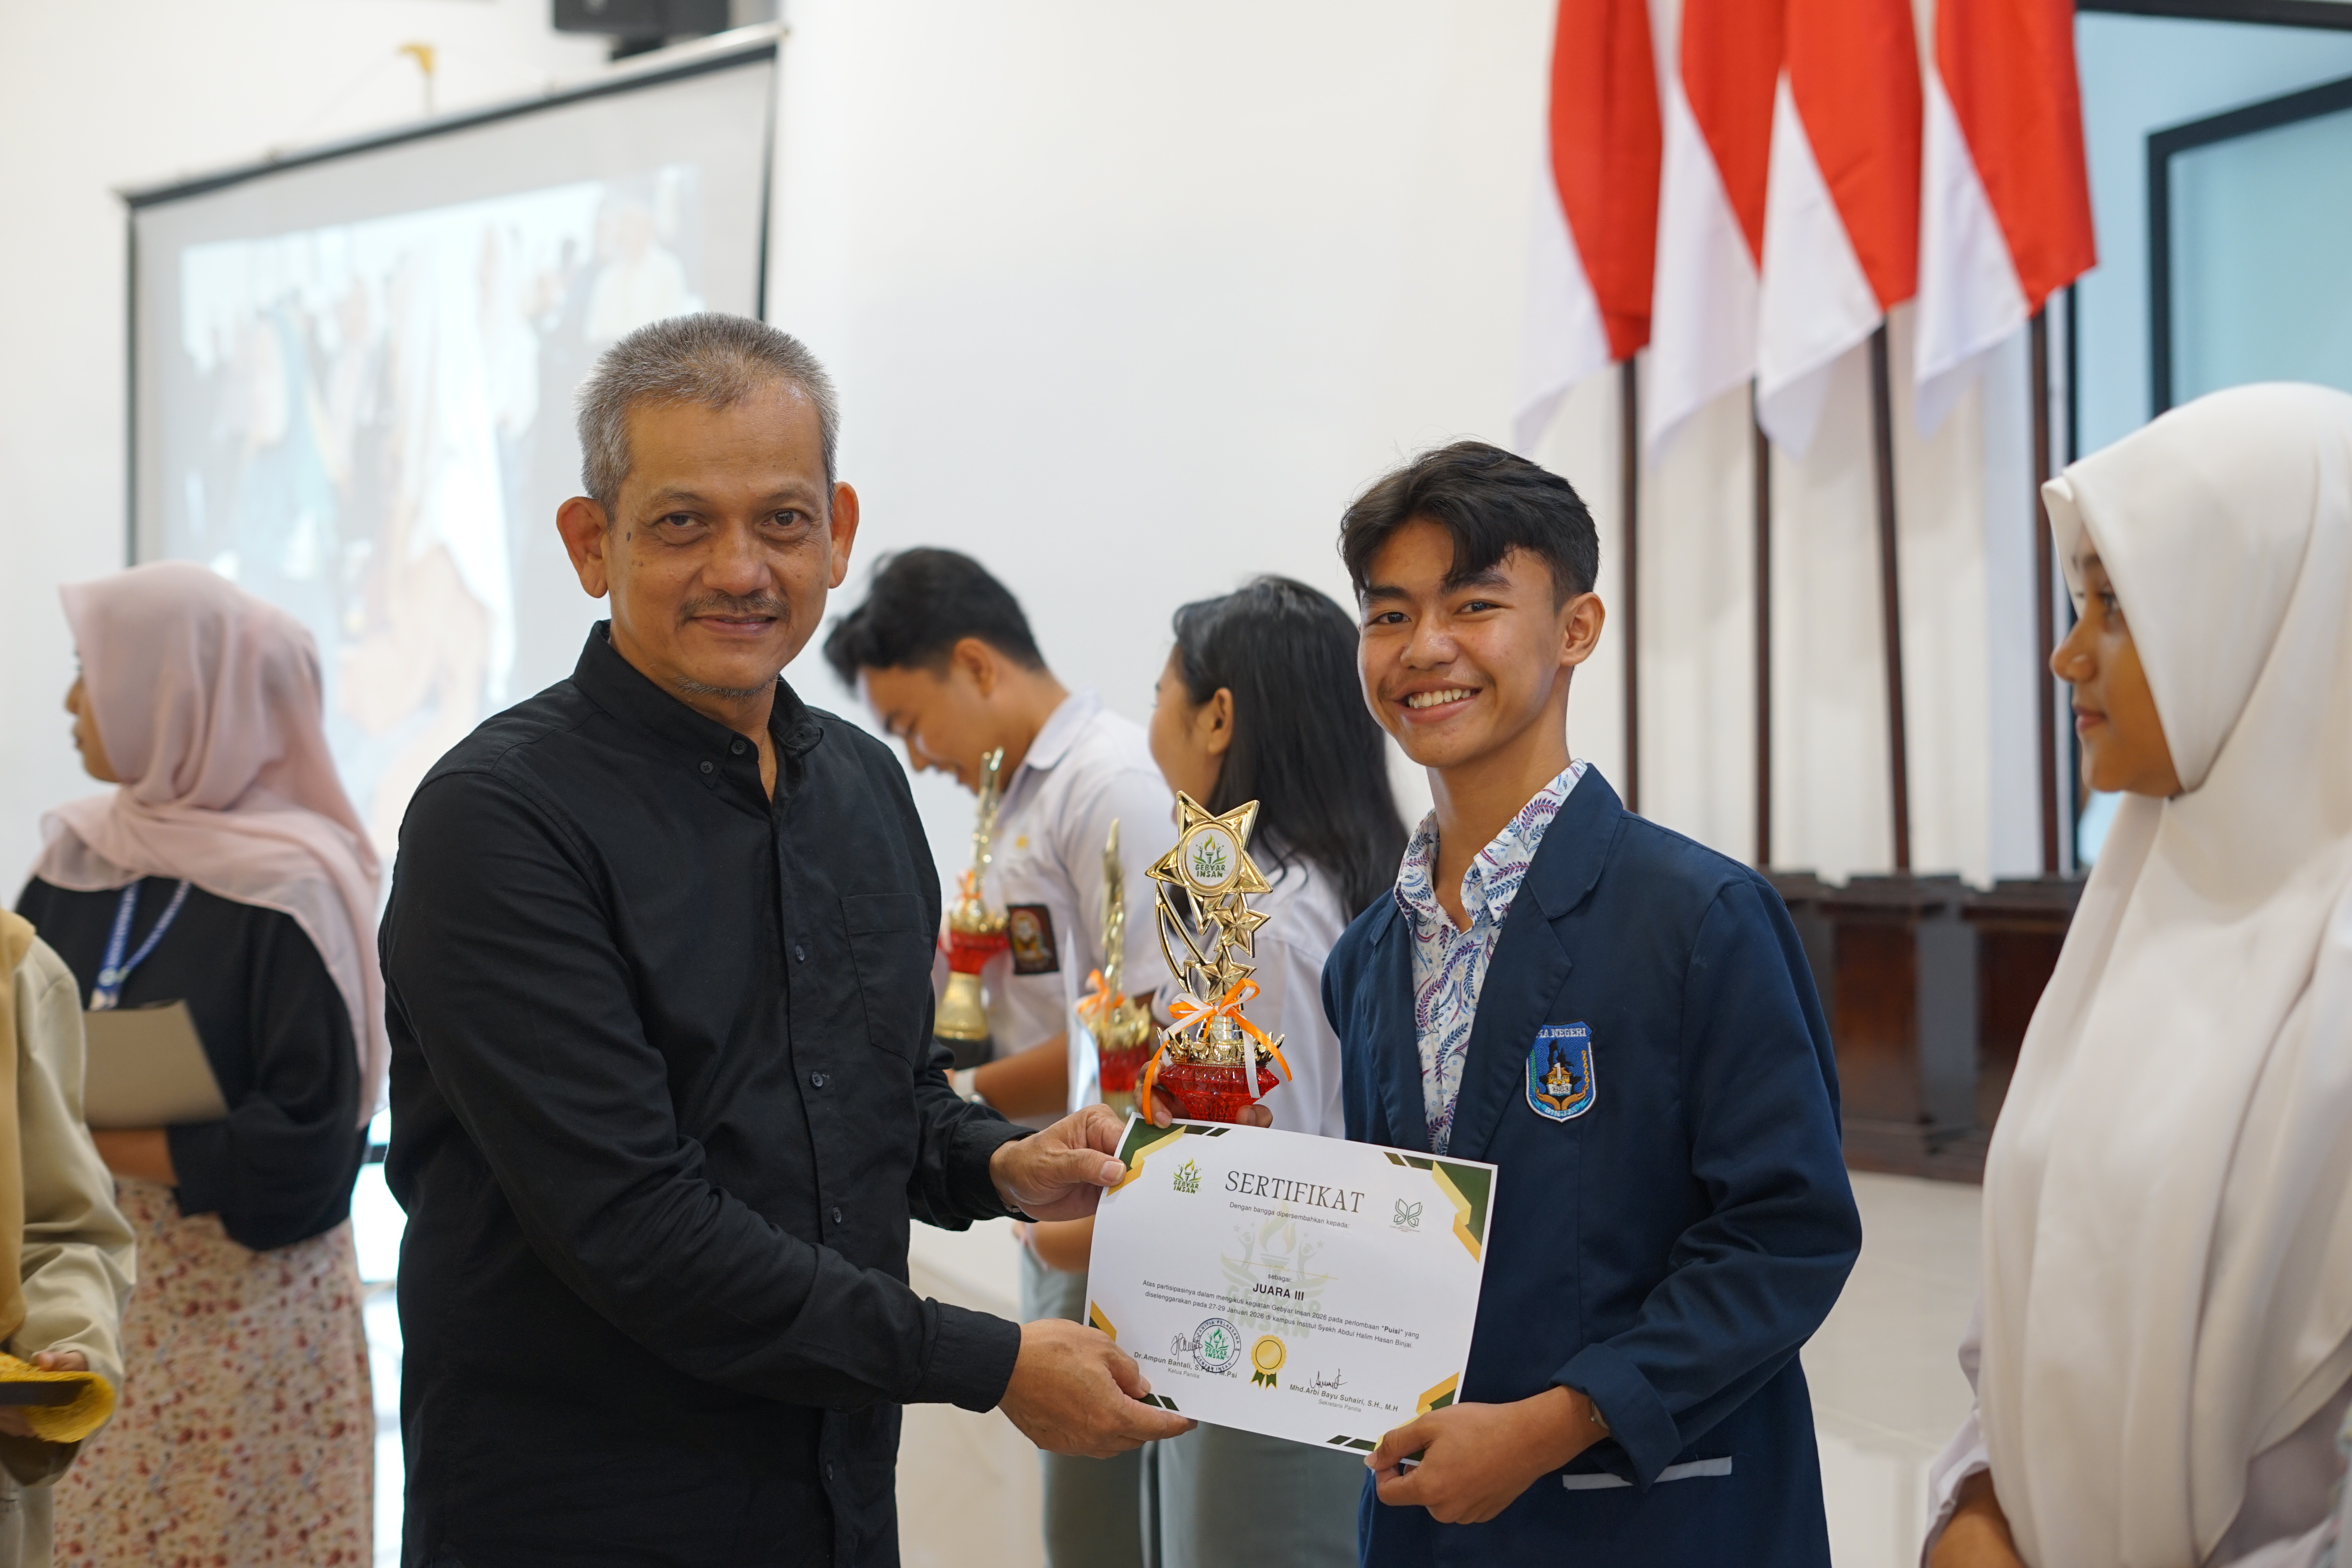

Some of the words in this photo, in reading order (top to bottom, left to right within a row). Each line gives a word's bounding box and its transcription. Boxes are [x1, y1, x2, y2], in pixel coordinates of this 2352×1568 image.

[1550, 1028, 1586, 1038] NEGERI
[1545, 1107, 1577, 1117] BINJAI
[1174, 1180, 1199, 1189] GEBYAR
[1174, 1185, 1195, 1194] INSAN
[1225, 1171, 1365, 1213] SERTIFIKAT
[1230, 1202, 1252, 1211] Dengan
[1254, 1206, 1275, 1216] bangga
[1276, 1210, 1324, 1224] dipersembahkan
[1326, 1219, 1349, 1228] kepada:
[1268, 1274, 1292, 1283] sebagai:
[1253, 1283, 1290, 1298] JUARA
[1295, 1290, 1304, 1301] III
[1157, 1282, 1195, 1295] partisipasinya
[1197, 1290, 1214, 1299] dalam
[1216, 1294, 1244, 1304] mengikuti
[1246, 1300, 1270, 1309] kegiatan
[1272, 1305, 1293, 1314] Gebyar
[1294, 1309, 1310, 1317] Insan
[1328, 1316, 1343, 1324] pada
[1345, 1319, 1379, 1330] perlombaan
[1405, 1331, 1419, 1339] yang
[1145, 1291, 1191, 1305] diselenggarakan
[1227, 1307, 1248, 1316] Januari
[1272, 1316, 1295, 1325] kampus
[1297, 1320, 1316, 1329] Institut
[1318, 1324, 1336, 1333] Syekh
[1338, 1328, 1354, 1337] Abdul
[1356, 1332, 1372, 1340] Halim
[1374, 1336, 1393, 1344] Hasan
[1395, 1339, 1413, 1348] Binjai.
[1197, 1321, 1214, 1337] PANITIA
[1217, 1320, 1240, 1344] PELAKSANA
[1205, 1347, 1227, 1356] GEBYAR
[1205, 1352, 1225, 1360] INSAN
[1134, 1352, 1166, 1364] Dr.Ampun
[1168, 1359, 1192, 1370] Bantali,
[1216, 1362, 1231, 1371] INSAN
[1290, 1384, 1320, 1396] Mhd.Arbi
[1321, 1390, 1338, 1400] Bayu
[1339, 1394, 1365, 1406] Suhairi,
[1367, 1400, 1383, 1410] S.H.,
[1318, 1399, 1343, 1408] Sekretaris
